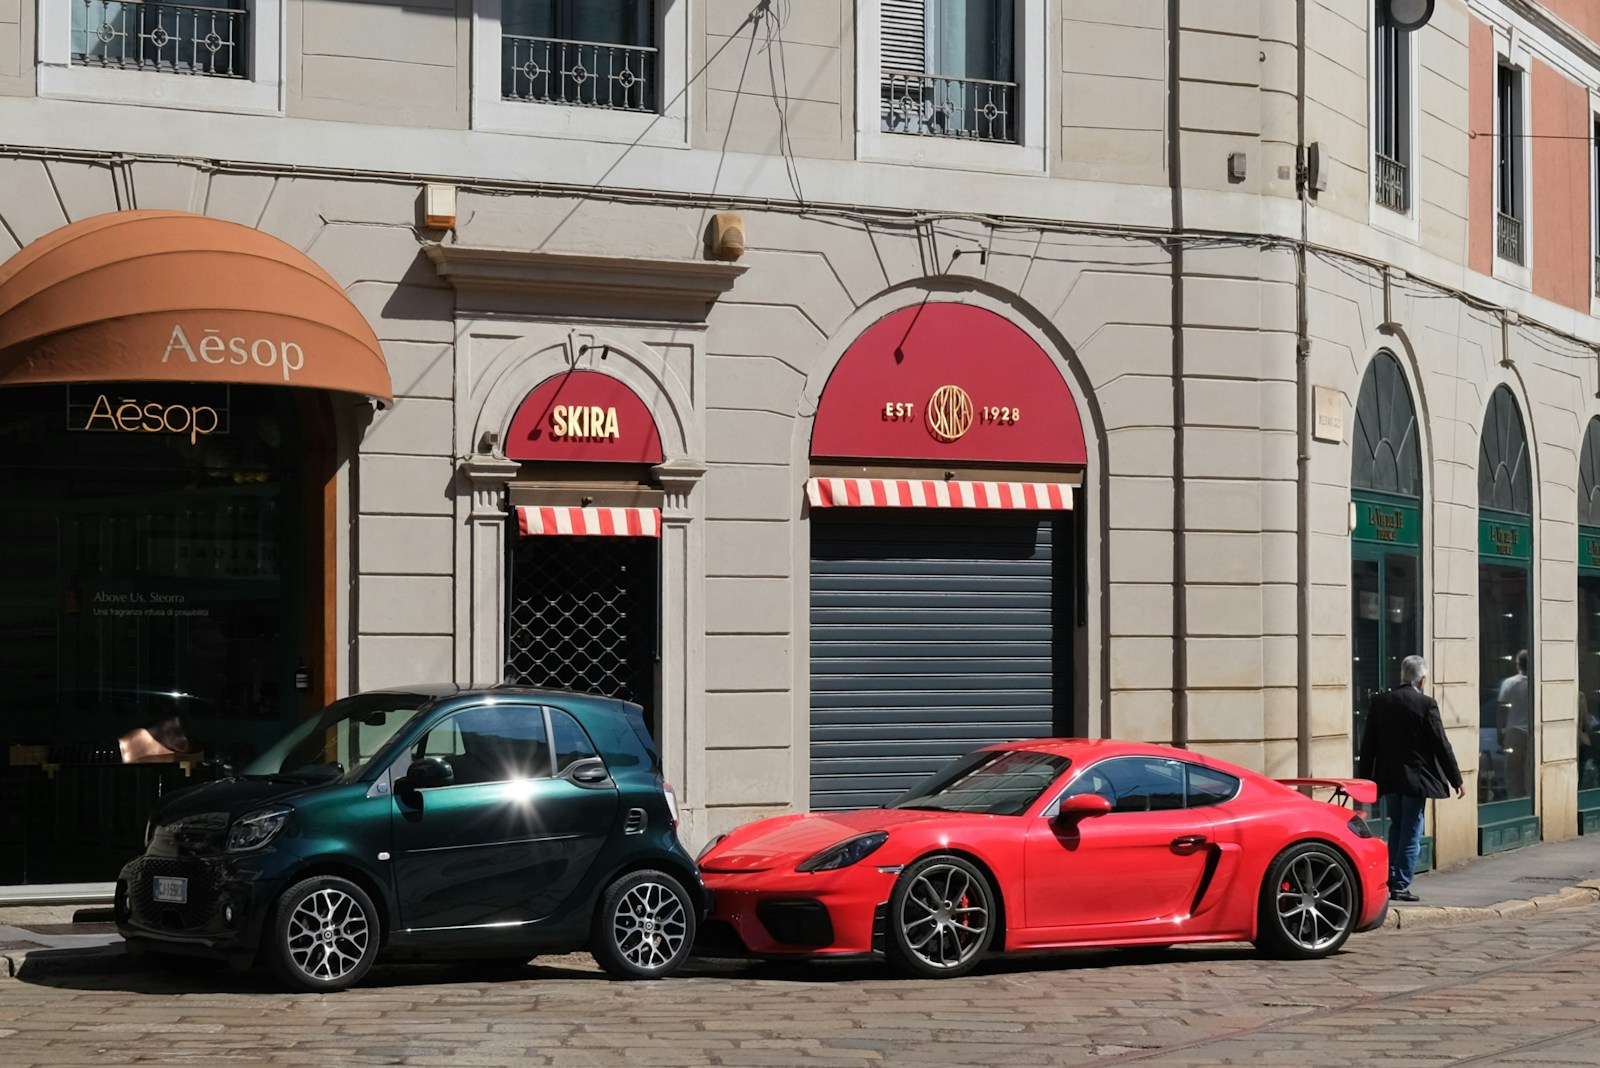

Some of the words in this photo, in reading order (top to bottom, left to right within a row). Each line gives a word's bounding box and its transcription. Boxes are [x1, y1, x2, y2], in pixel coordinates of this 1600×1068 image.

[885, 402, 914, 417] EST
[983, 406, 1020, 422] 1928
[552, 404, 621, 439] SKIRA
[93, 591, 128, 602] Above
[93, 607, 108, 615] Una
[109, 607, 143, 617] fragranza
